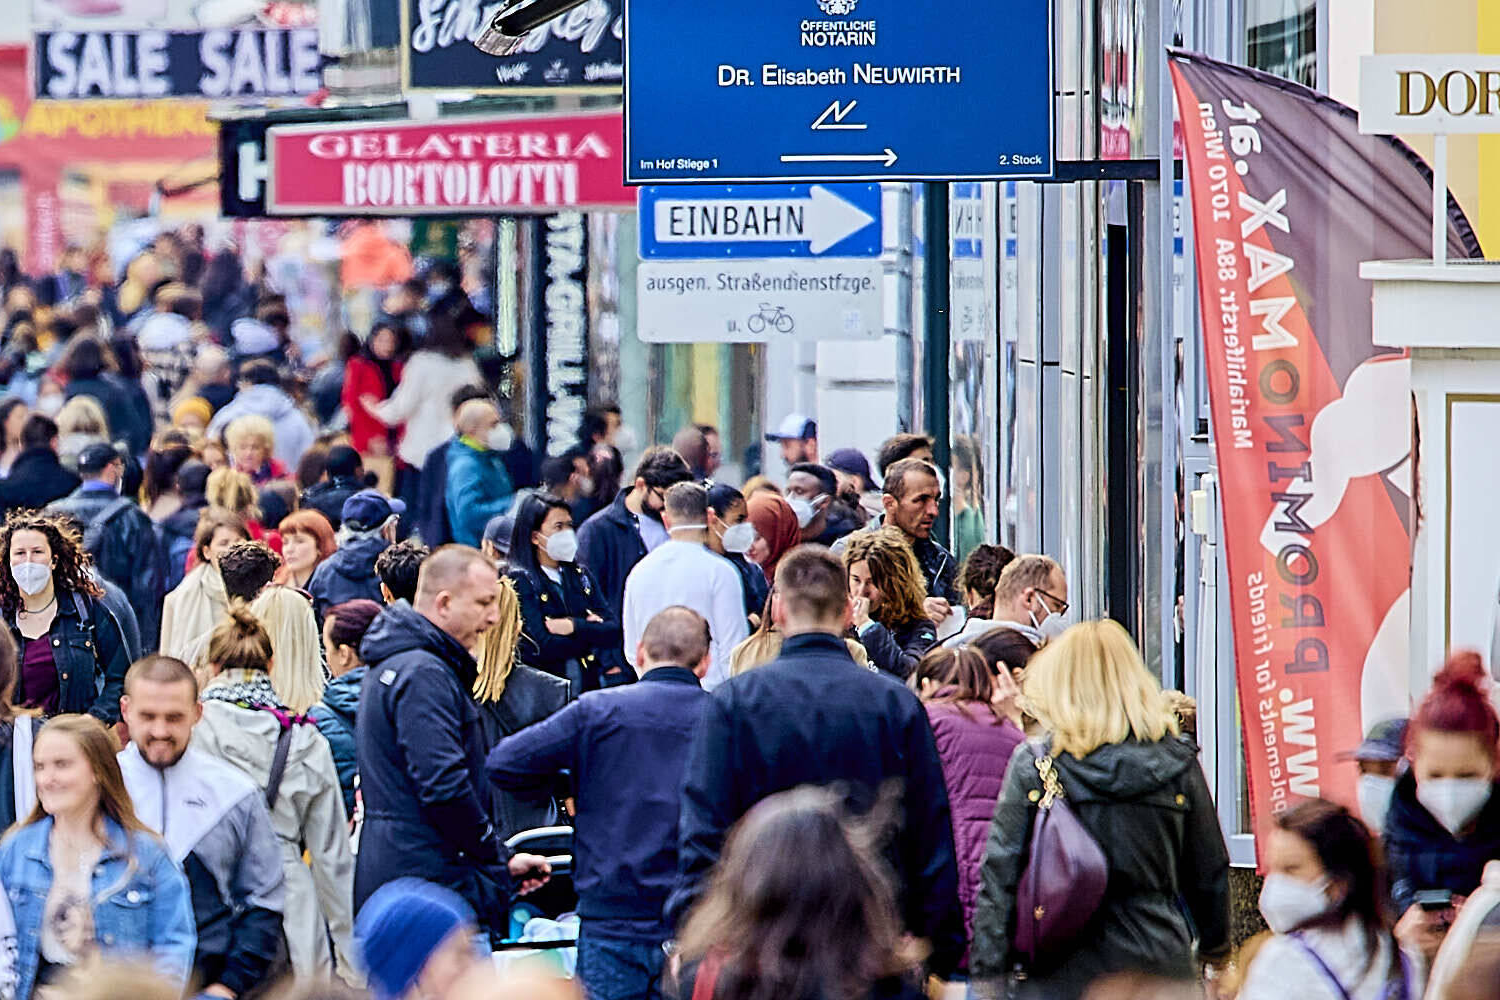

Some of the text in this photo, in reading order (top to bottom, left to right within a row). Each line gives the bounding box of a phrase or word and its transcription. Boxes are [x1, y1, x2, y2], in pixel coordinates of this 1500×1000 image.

[800, 20, 876, 32] ÖFFENTLICHE
[801, 31, 876, 46] NOTARIN
[47, 29, 320, 96] SALE SALE
[762, 65, 847, 86] Elisabeth
[853, 63, 961, 85] NEUWIRTH
[308, 133, 612, 160] GELATERIA
[640, 159, 718, 171] Im Hof Stiege 1
[999, 154, 1042, 166] 2. Stock
[342, 161, 580, 206] BORTOLOTTI
[669, 205, 804, 236] EINBAHN
[646, 272, 876, 295] ausgen. Straßendienstfzge.
[727, 320, 741, 332] u.
